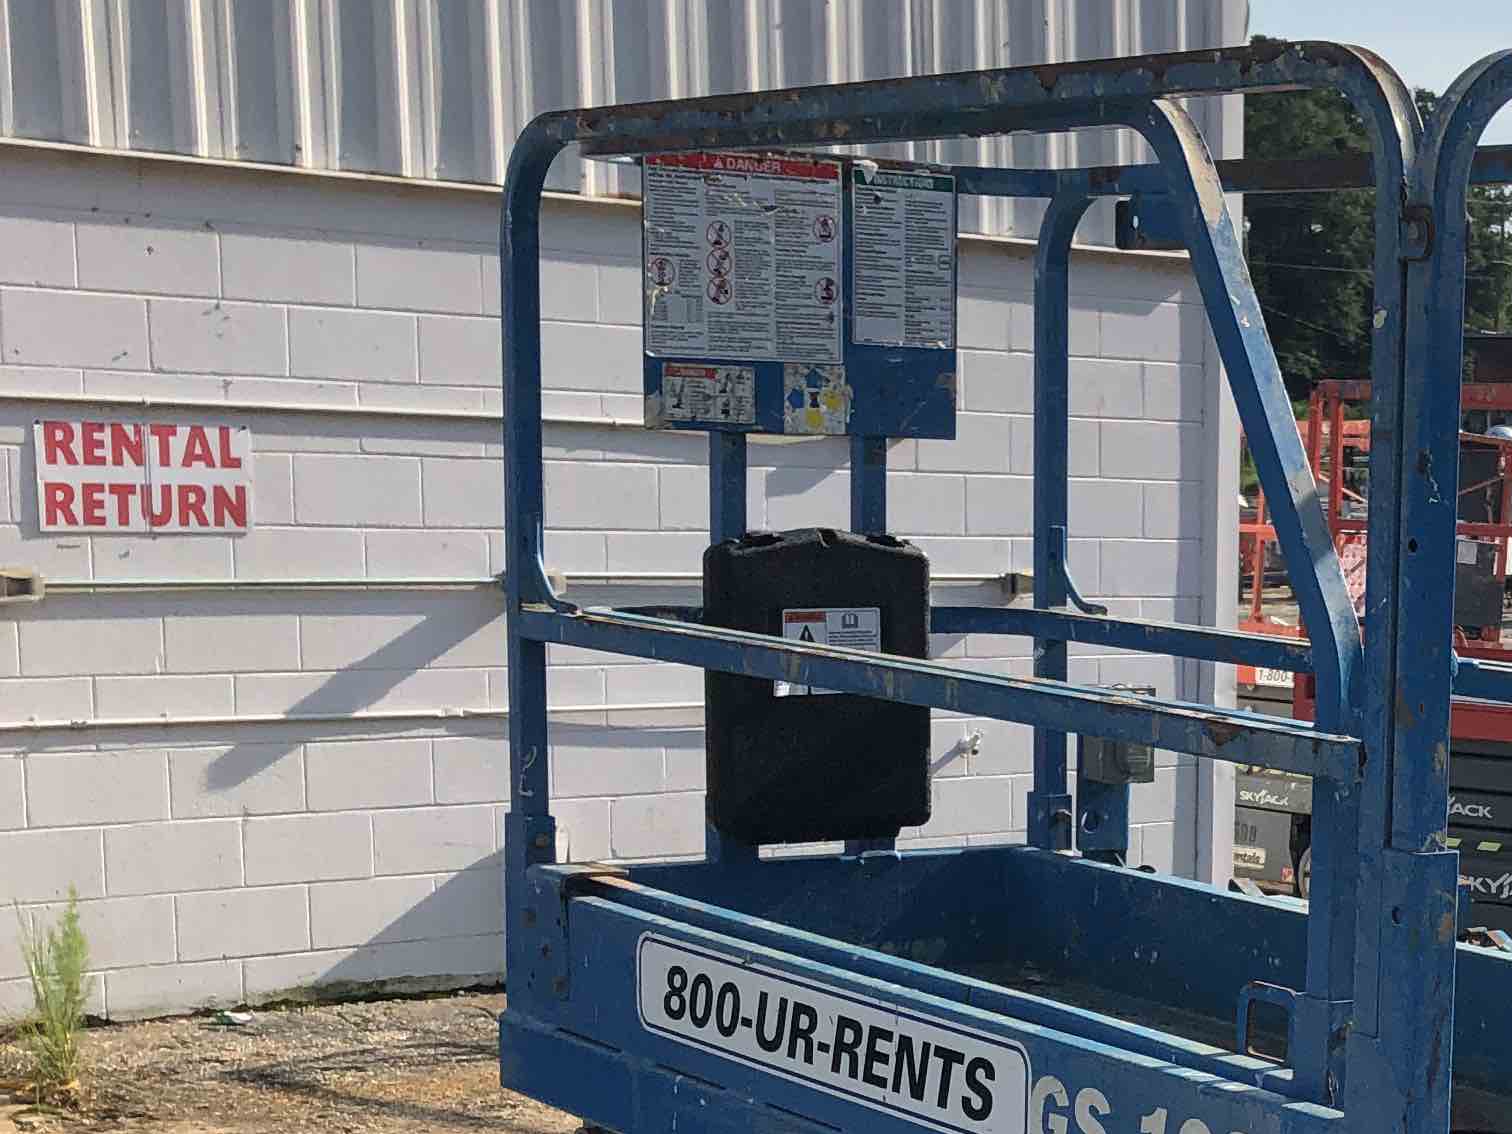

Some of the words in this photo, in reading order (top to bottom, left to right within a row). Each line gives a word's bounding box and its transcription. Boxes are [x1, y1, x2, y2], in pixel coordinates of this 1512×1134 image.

[43, 421, 241, 469] RENTAL
[44, 482, 247, 528] RETURN
[663, 966, 996, 1121] 800-UR-RENTS
